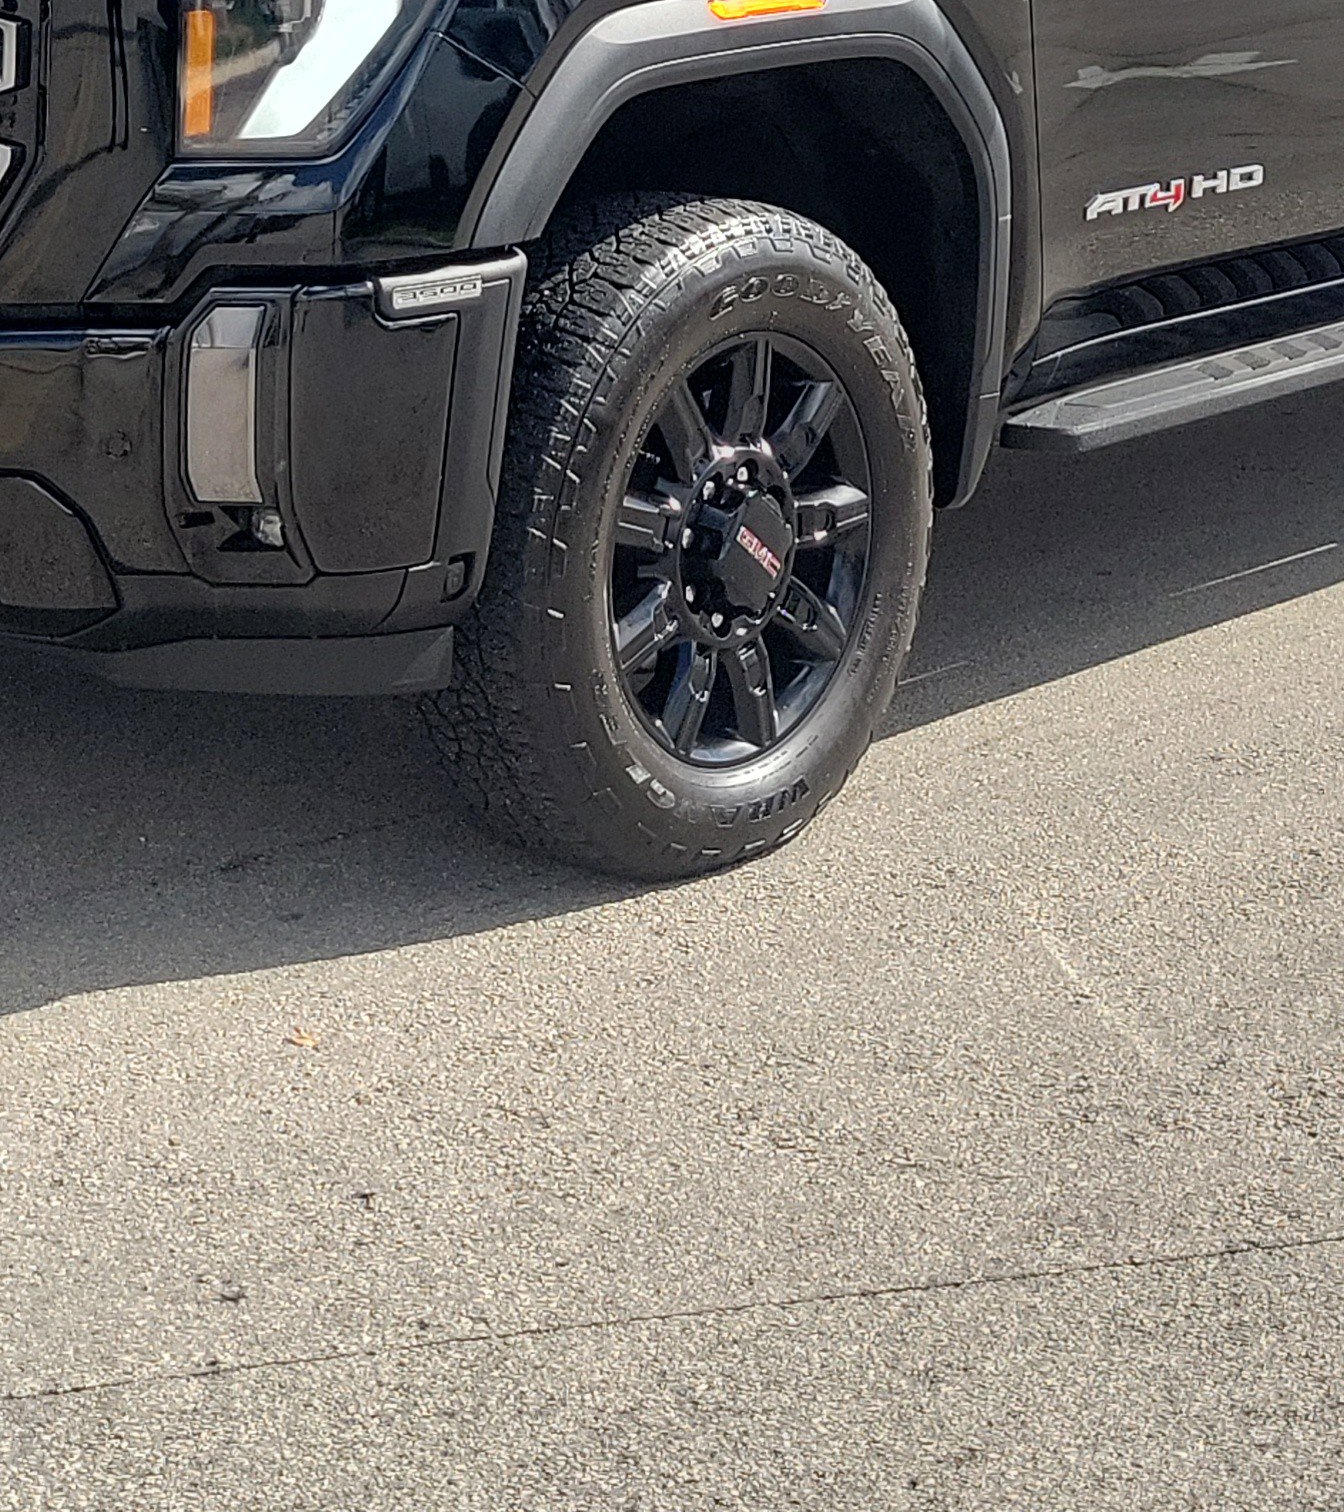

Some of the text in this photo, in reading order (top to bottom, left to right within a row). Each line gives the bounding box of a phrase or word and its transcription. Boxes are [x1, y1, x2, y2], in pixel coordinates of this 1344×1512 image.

[1085, 163, 1265, 222] AT4 HD
[709, 272, 918, 453] GOODYEAR
[736, 524, 782, 579] GMC
